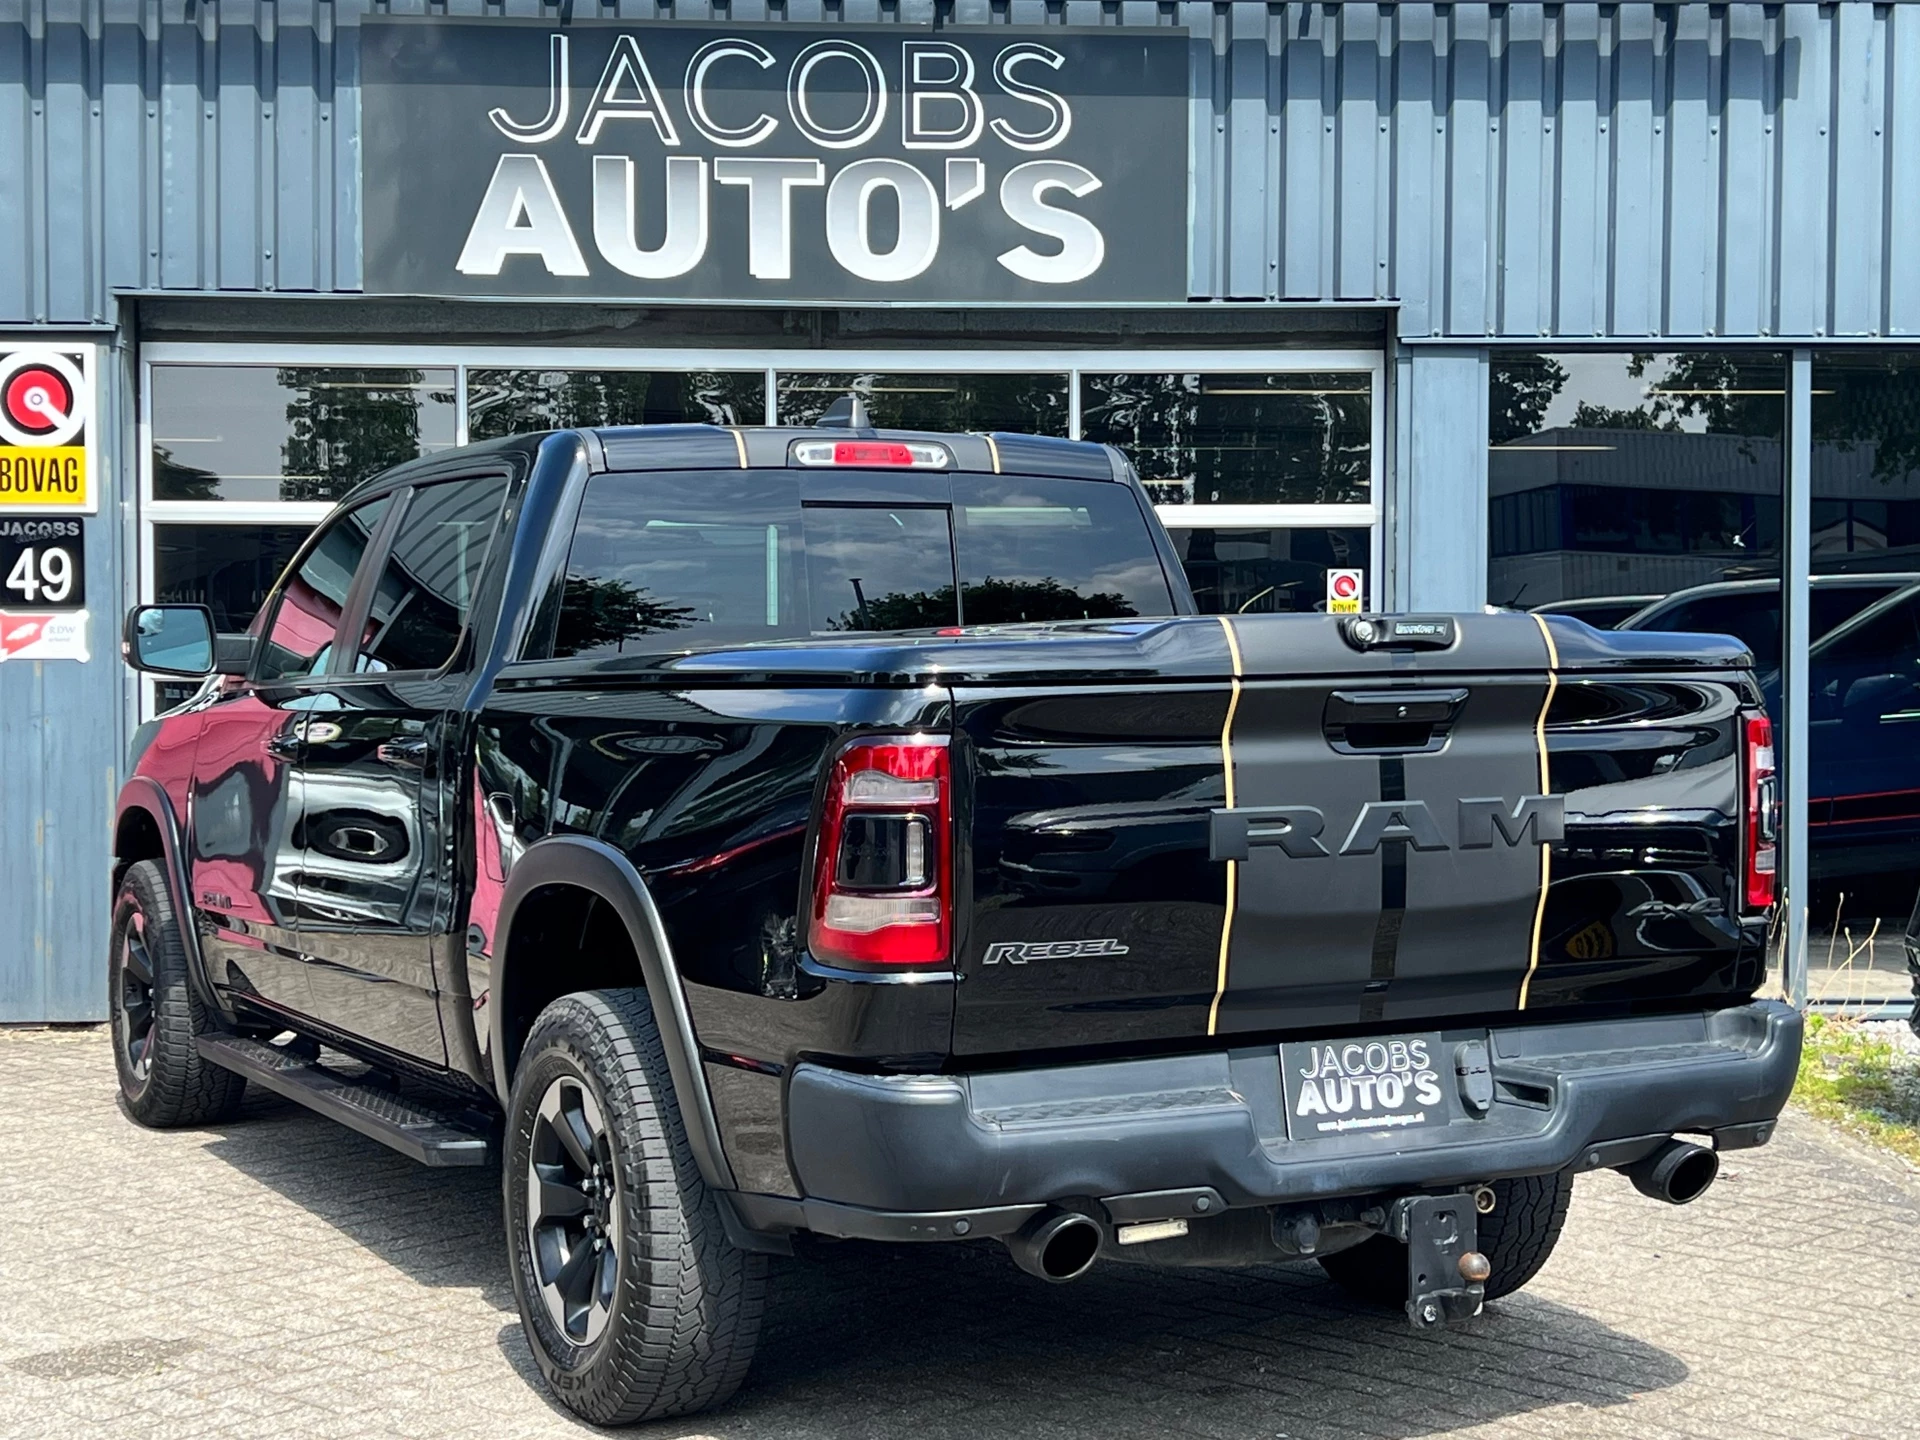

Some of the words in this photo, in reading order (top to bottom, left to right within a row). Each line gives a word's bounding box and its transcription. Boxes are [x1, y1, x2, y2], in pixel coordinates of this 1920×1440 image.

[488, 33, 1073, 151] JACOBS
[455, 153, 1105, 283] AUTO'S
[0, 457, 79, 493] BOVAG
[0, 521, 80, 536] JACOBS
[5, 547, 72, 602] 49
[48, 625, 77, 634] RDW
[1210, 793, 1566, 861] RAM
[982, 938, 1130, 965] REBEL
[1299, 1038, 1431, 1079] JACOBS
[1296, 1069, 1442, 1116] AUTO'S
